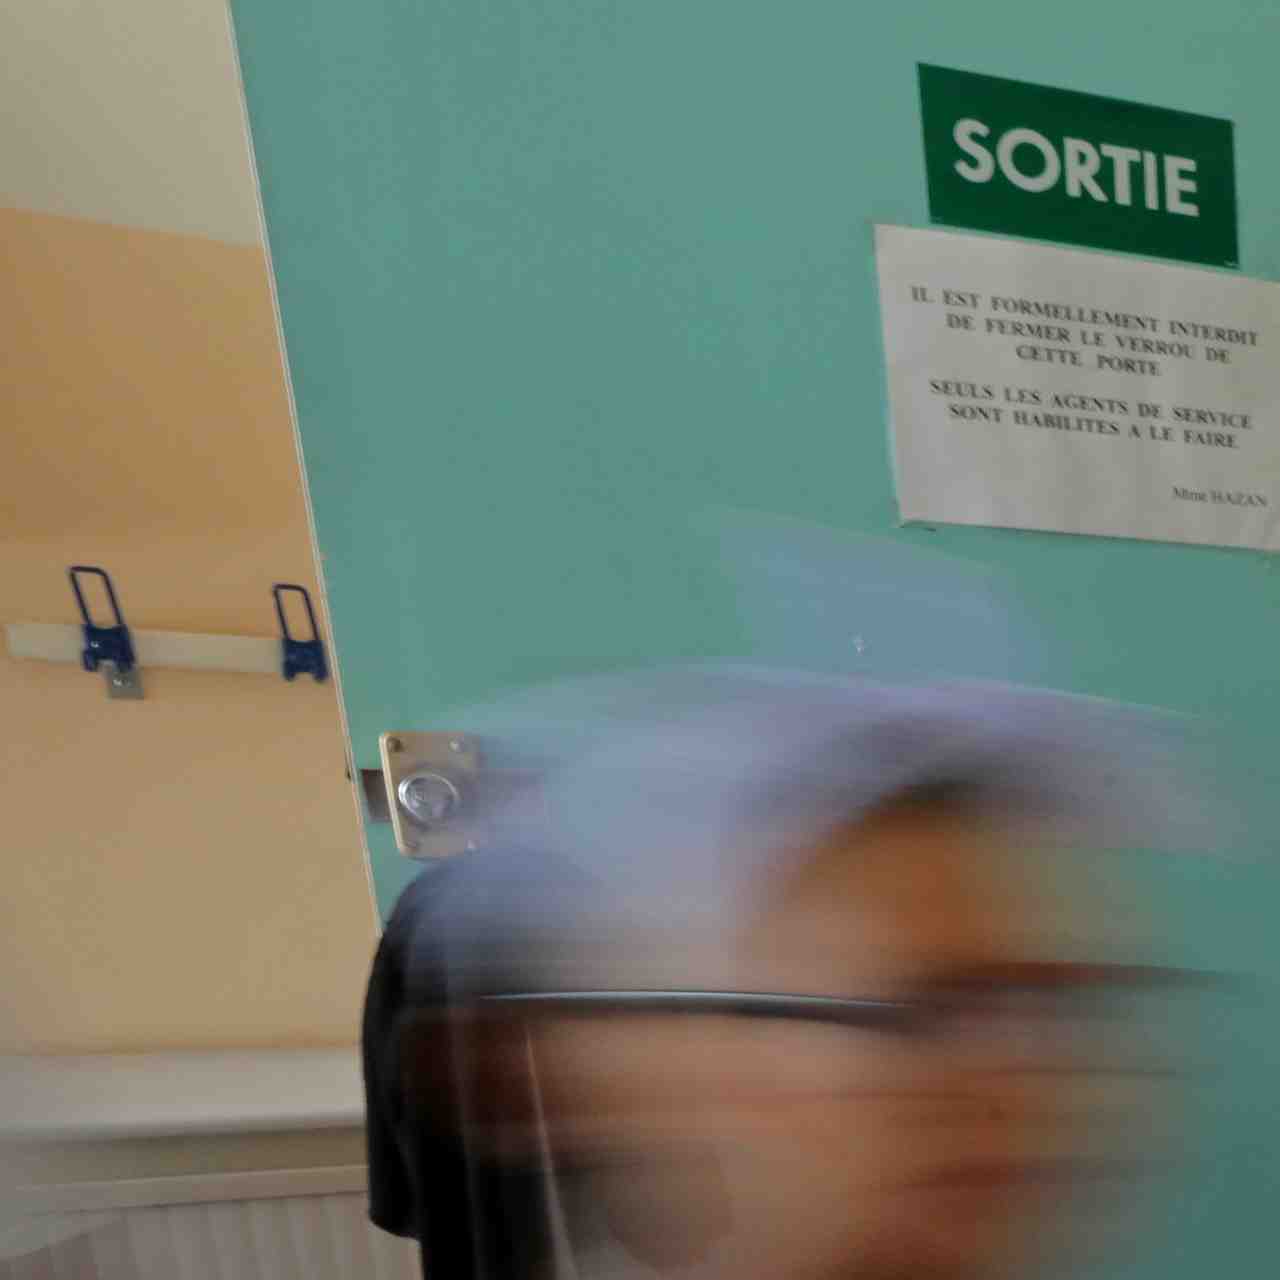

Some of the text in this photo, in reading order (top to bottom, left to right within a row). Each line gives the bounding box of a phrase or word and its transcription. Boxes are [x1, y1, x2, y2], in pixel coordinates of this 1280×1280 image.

[952, 116, 1200, 217] SORTIE
[911, 286, 1258, 347] IL EST FORMELLEMENT INTERDIT
[946, 313, 1231, 364] DE FERMER LE VERROU DE
[1016, 344, 1161, 376] CETTE PORTE
[930, 380, 1252, 429] SEULS LES AGENTS DE SERVICE
[948, 404, 1237, 448] SONT HABILITES A LE FAIRE
